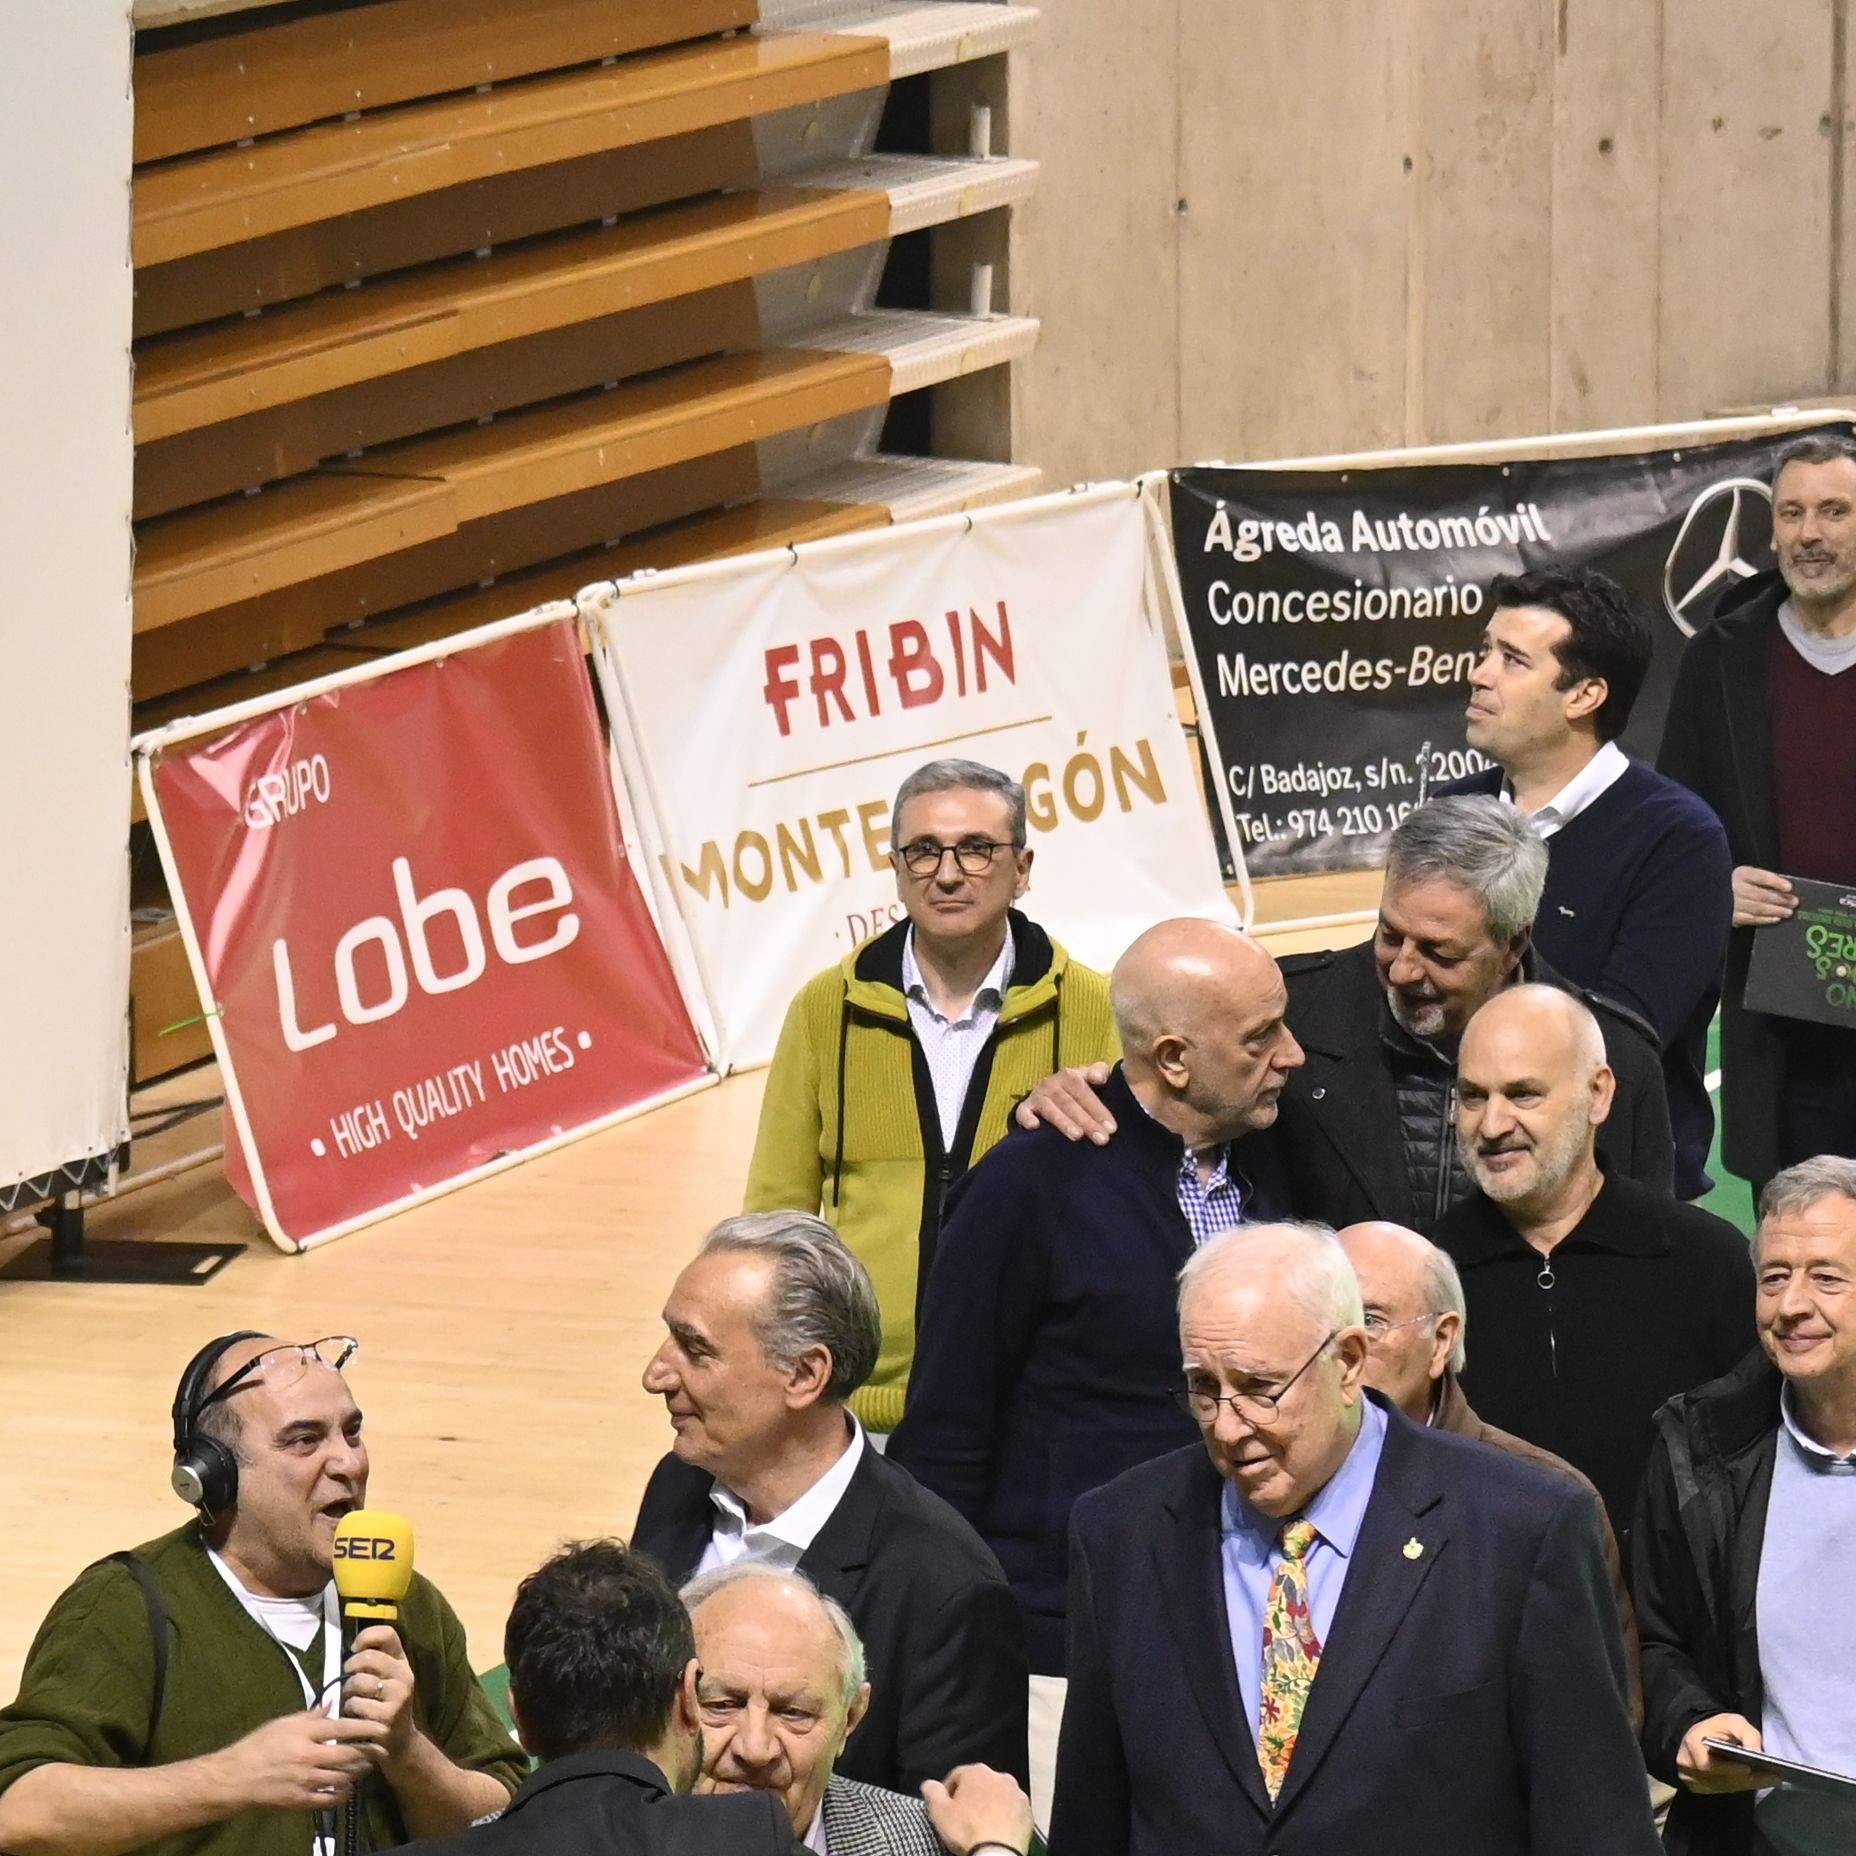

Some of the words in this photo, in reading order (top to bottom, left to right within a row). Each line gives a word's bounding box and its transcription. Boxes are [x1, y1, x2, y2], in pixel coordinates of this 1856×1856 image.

[1203, 500, 1344, 562] Ágreda
[1352, 503, 1552, 552] Automóvil
[1208, 575, 1483, 626] Concesionario
[763, 600, 1015, 737] FRIBIN
[1216, 645, 1487, 698] Mercedes-Ben
[244, 753, 331, 829] GRUPO
[1229, 765, 1255, 799] C/
[1260, 760, 1362, 798] Badajoz,
[1365, 757, 1413, 790] s/n.
[1236, 811, 1287, 844] Tel.:
[1288, 807, 1334, 839] 974
[1336, 803, 1382, 836] 210
[1386, 801, 1419, 832] 16
[846, 904, 902, 948] DES
[273, 856, 580, 1052] Lobe
[330, 1100, 391, 1158] HIGH
[393, 1060, 486, 1140] QUALITY
[492, 1026, 574, 1092] HOMES
[333, 1537, 395, 1560] SER
